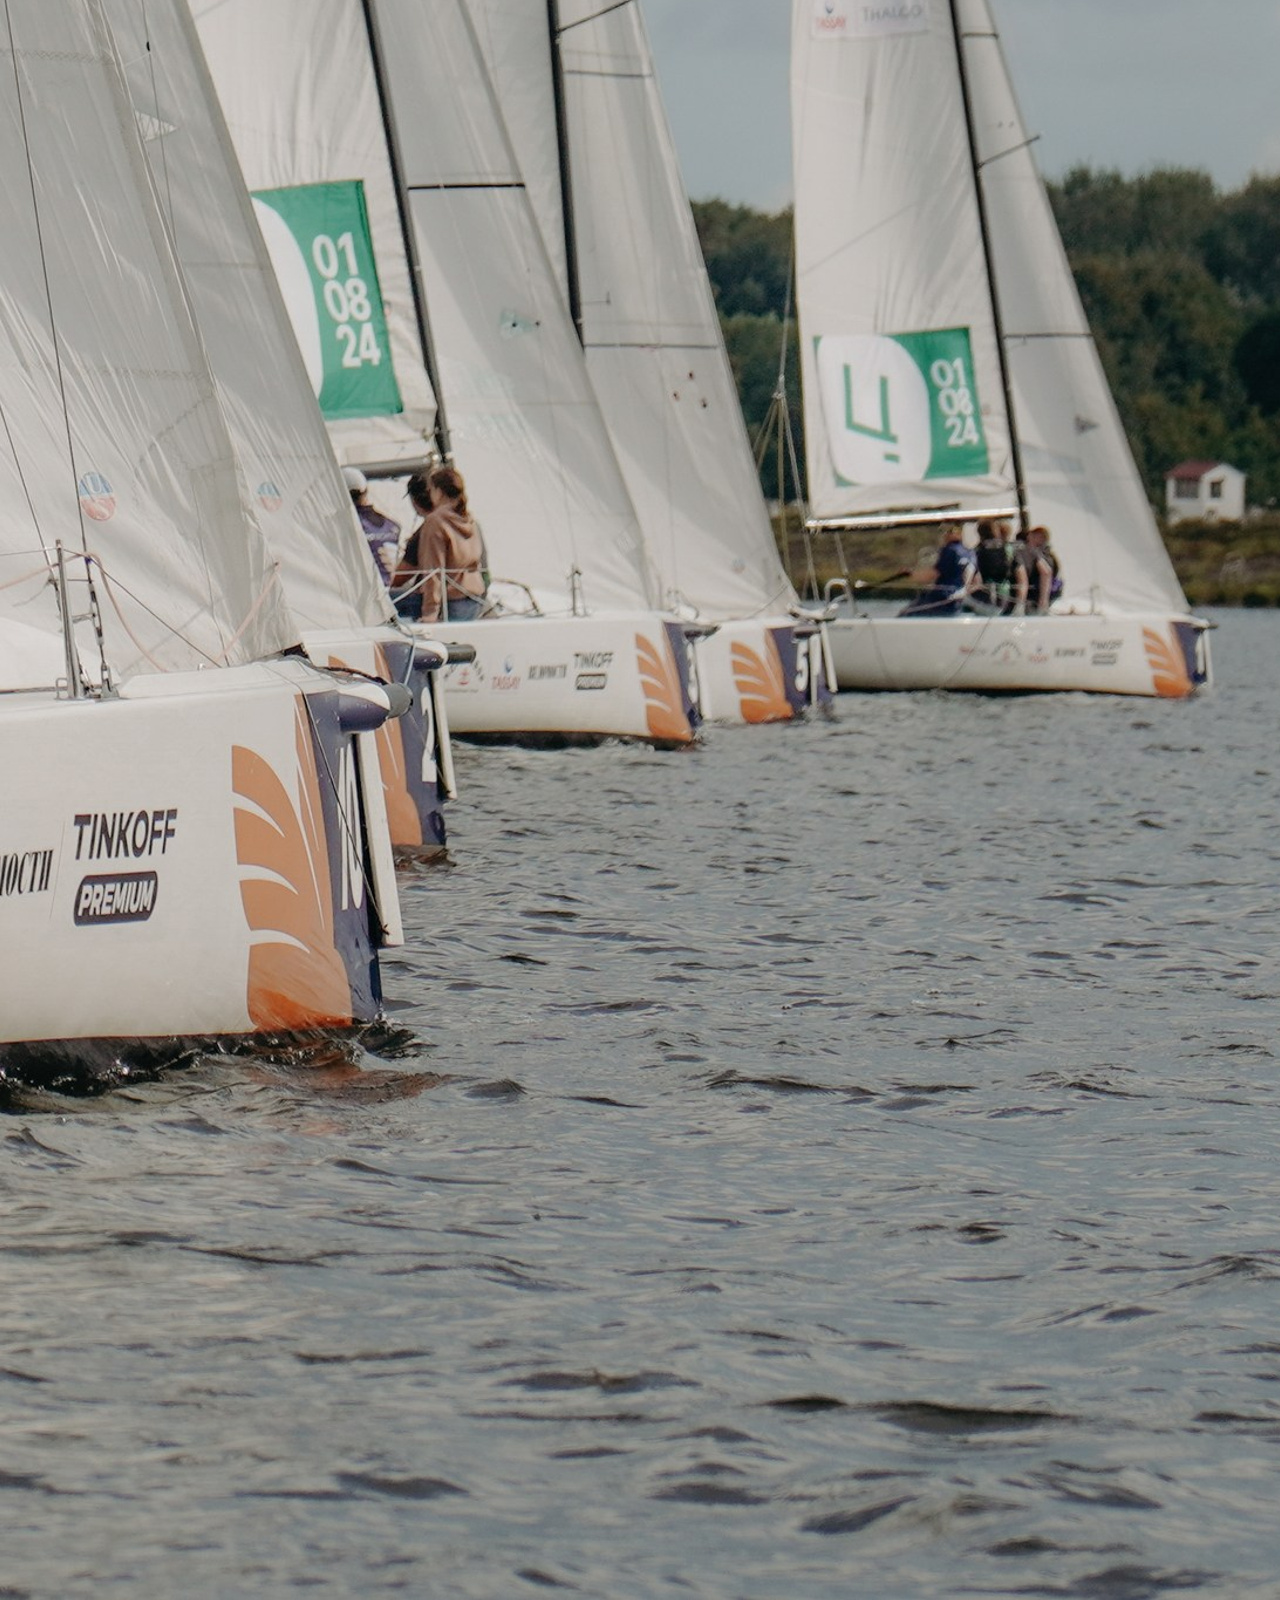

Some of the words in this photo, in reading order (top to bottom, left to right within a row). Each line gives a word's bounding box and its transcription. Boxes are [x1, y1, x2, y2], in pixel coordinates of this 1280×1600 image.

[312, 231, 359, 279] 01
[324, 277, 372, 323] 08
[336, 322, 381, 368] 24
[931, 357, 966, 389] 01
[938, 386, 973, 416] 08
[945, 415, 979, 447] 24
[74, 808, 178, 861] TINKOFF
[77, 879, 155, 917] PREMIUM
